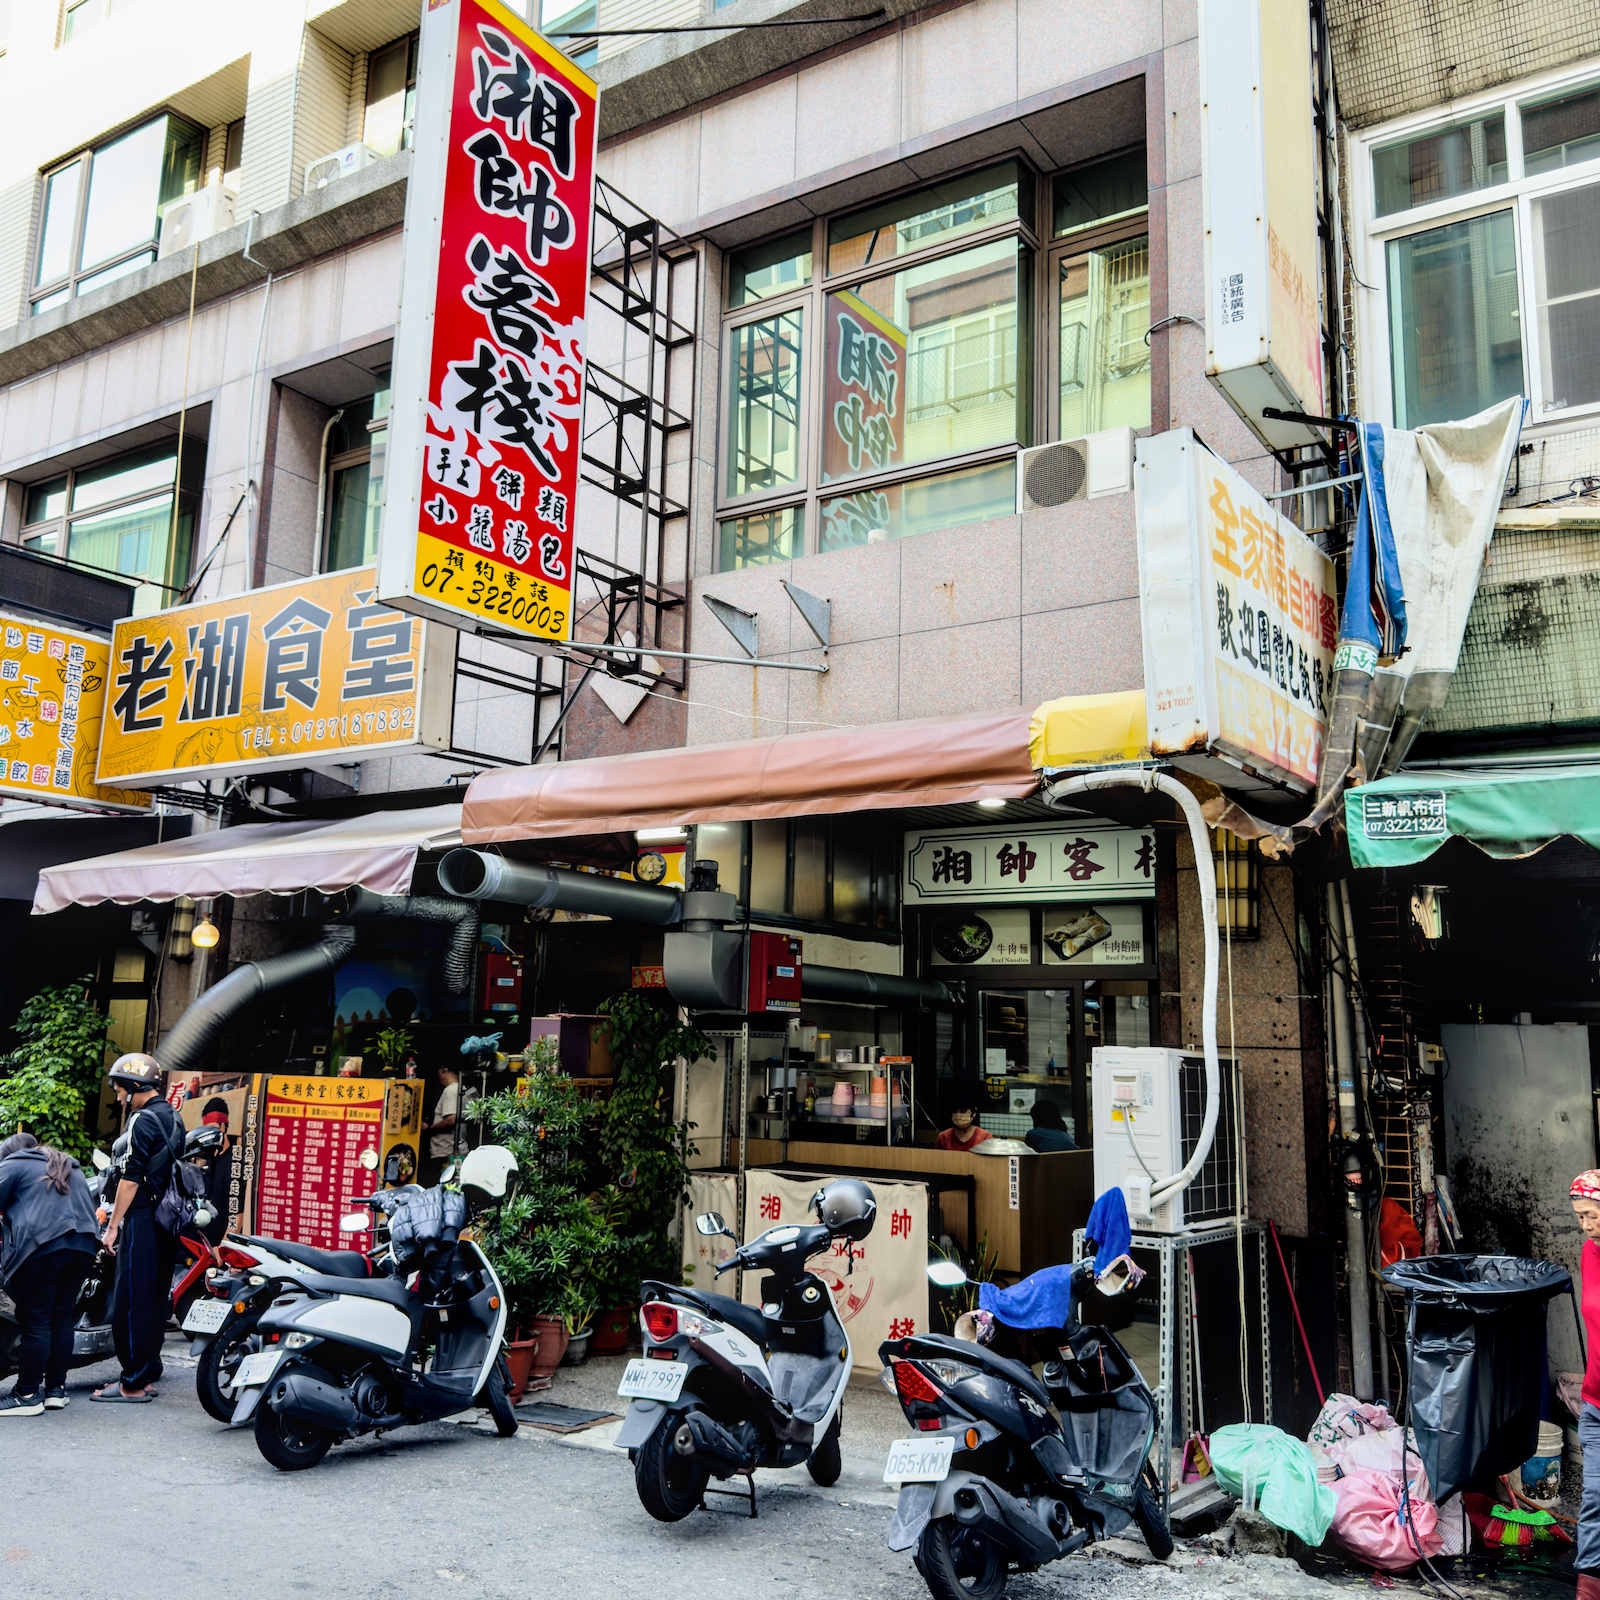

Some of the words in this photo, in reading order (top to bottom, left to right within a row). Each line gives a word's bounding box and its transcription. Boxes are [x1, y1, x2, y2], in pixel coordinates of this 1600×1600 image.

[454, 31, 575, 476] 湘帥客棧
[1229, 273, 1244, 322] 國統廣告
[436, 448, 567, 530] 手工餅類
[428, 498, 562, 577] 小籠湯包
[1209, 477, 1338, 654] 全家福自助餐
[422, 563, 565, 633] 07-3220003
[445, 549, 548, 602] 預約電話
[113, 592, 415, 733] 老湖食堂
[1366, 799, 1444, 818] 三新帆布行
[1366, 817, 1444, 833] (07)3221322
[1121, 954, 1141, 962] Pastry
[167, 1081, 185, 1110] 看
[243, 1095, 258, 1181] 民以食為天
[760, 1193, 781, 1220] 湘
[890, 1209, 911, 1240] 帥
